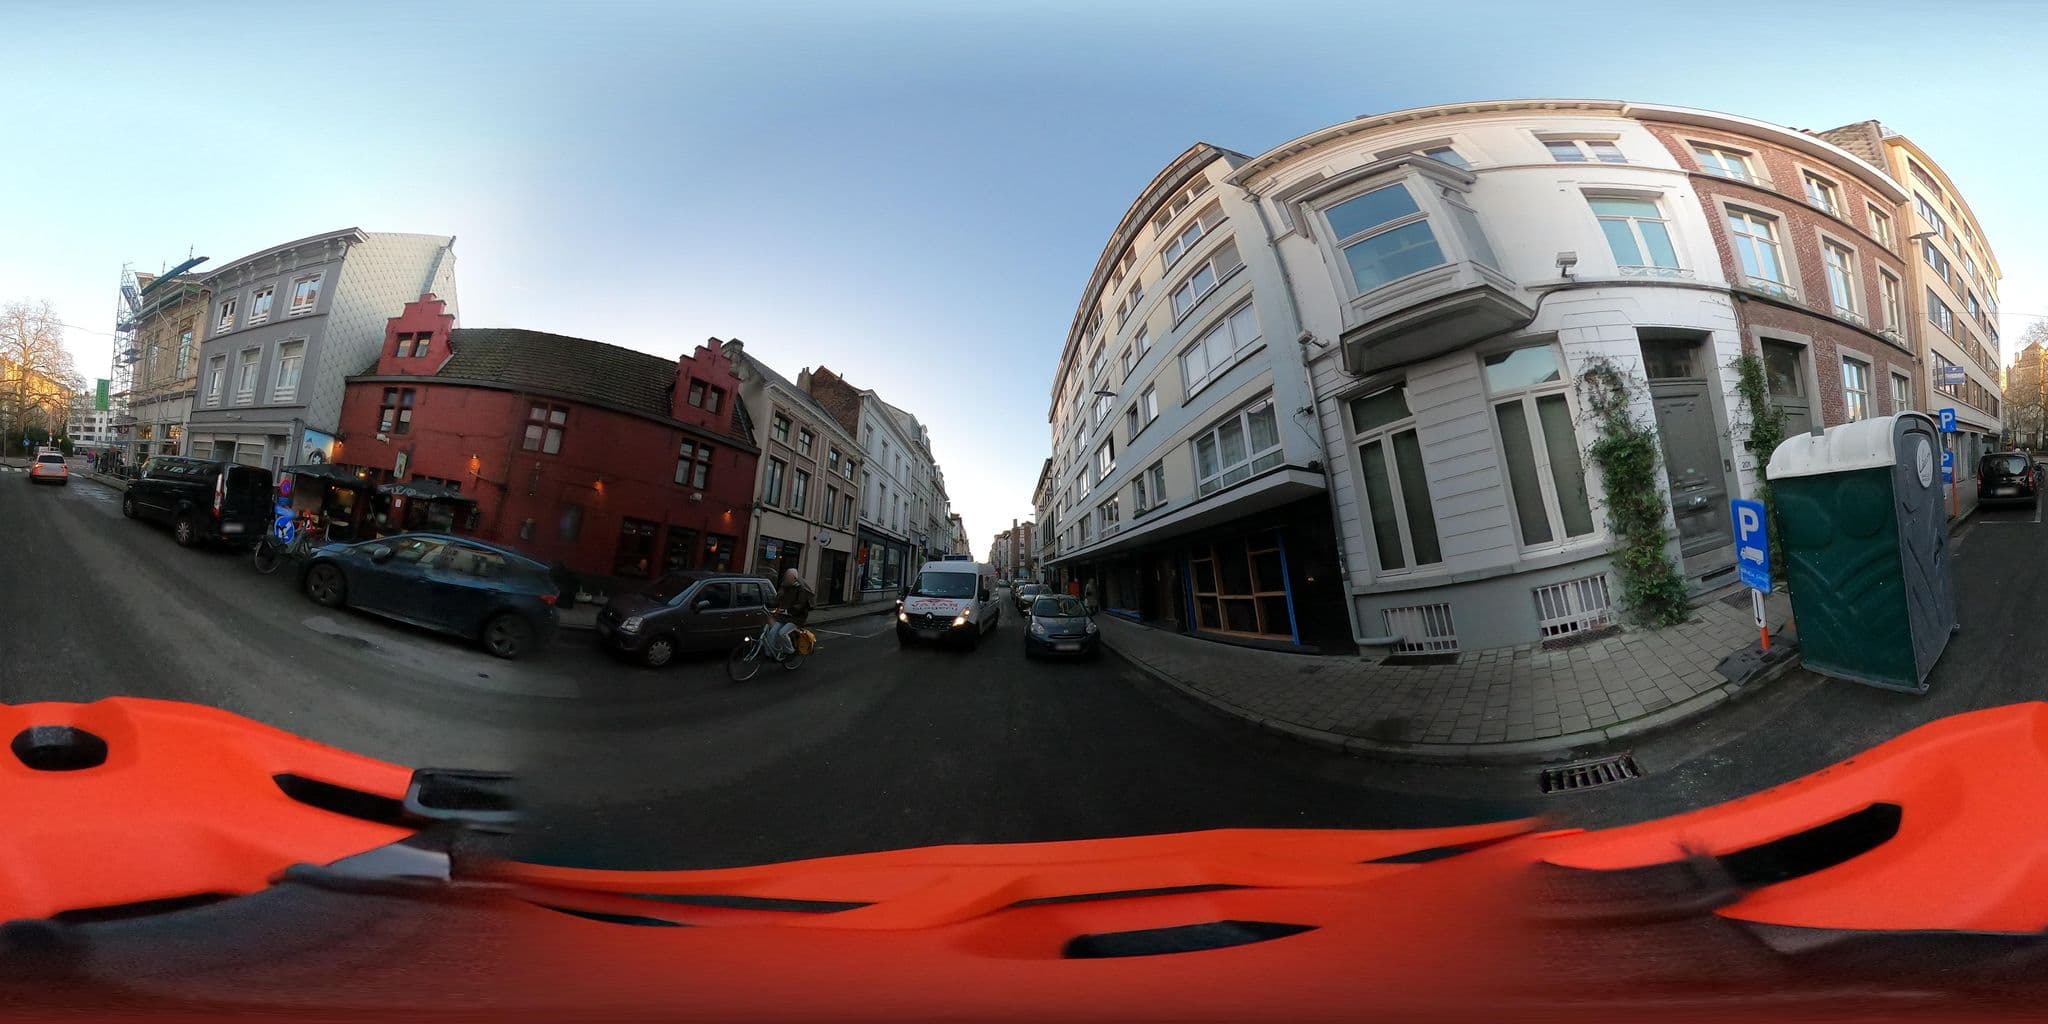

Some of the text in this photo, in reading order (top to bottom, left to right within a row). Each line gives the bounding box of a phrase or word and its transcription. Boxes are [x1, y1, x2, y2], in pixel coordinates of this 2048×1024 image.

[1941, 413, 1953, 429] P
[1941, 453, 1949, 466] P
[1738, 507, 1759, 542] P
